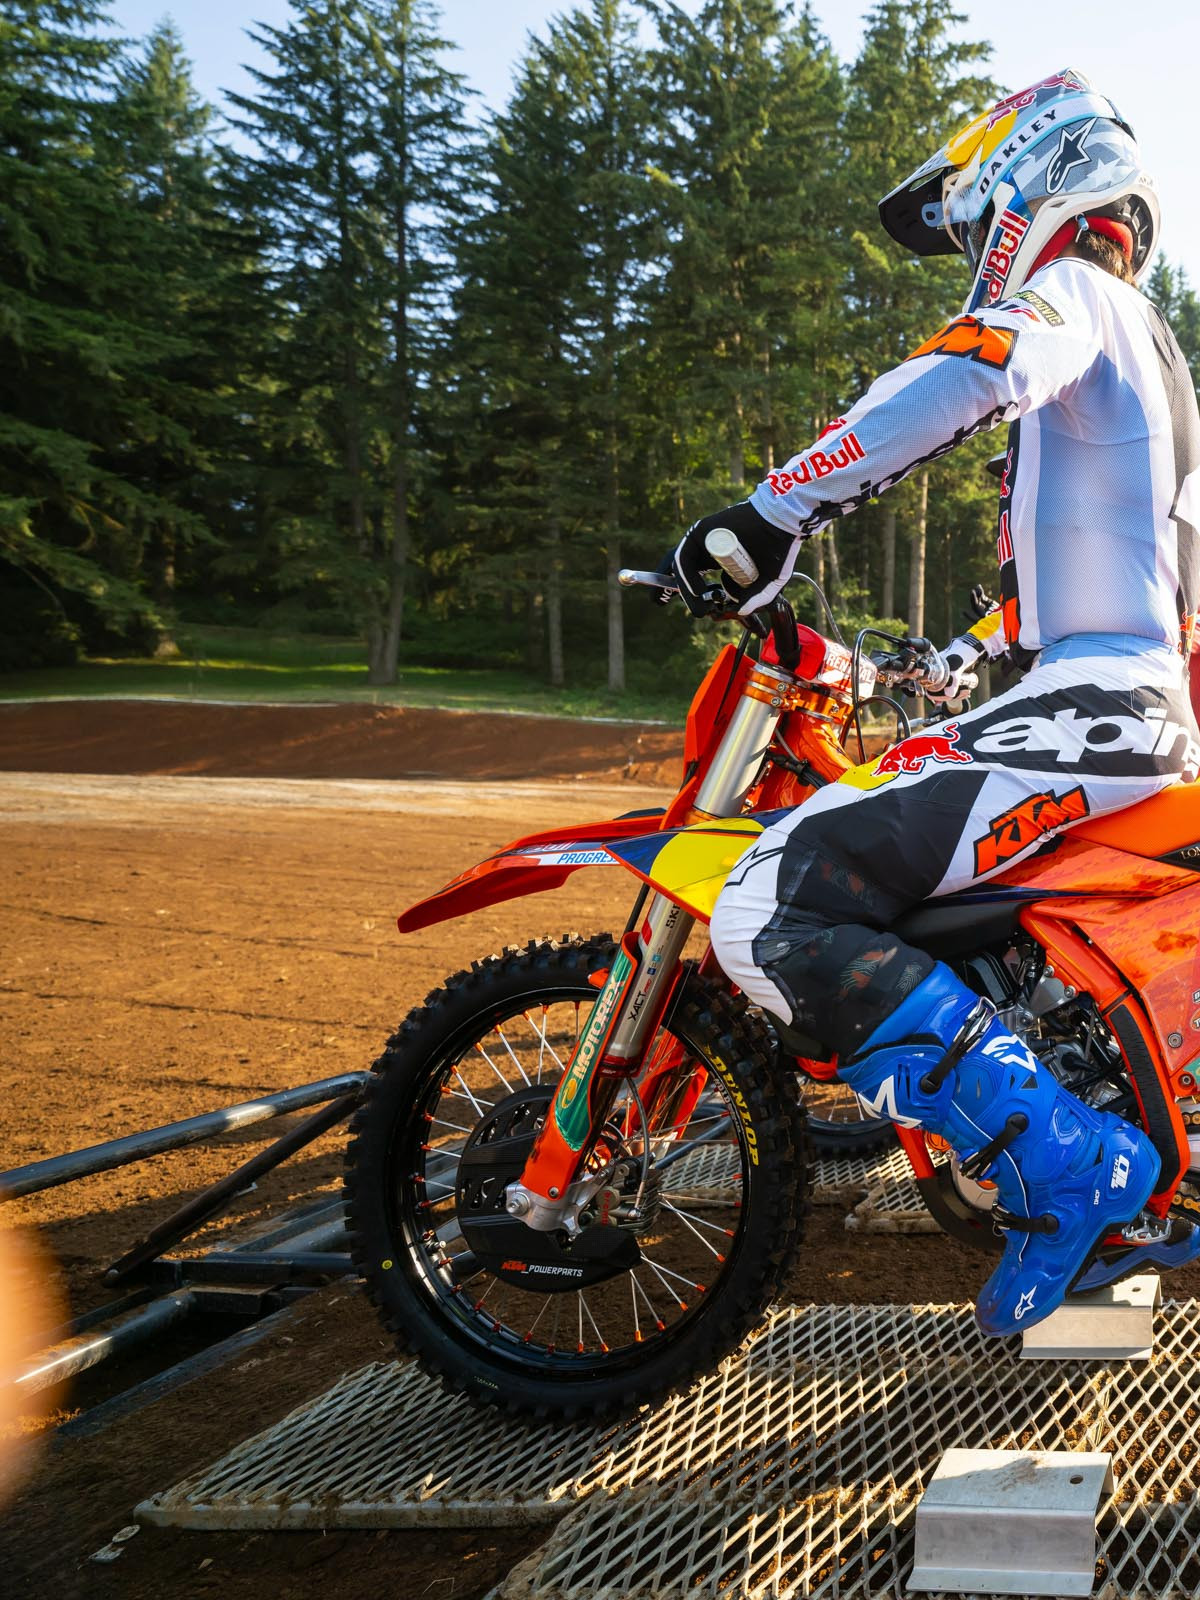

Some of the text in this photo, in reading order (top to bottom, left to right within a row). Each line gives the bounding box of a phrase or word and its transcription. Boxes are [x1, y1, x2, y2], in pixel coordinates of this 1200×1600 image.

[979, 109, 1058, 195] OAKLEY
[985, 209, 1029, 278] Bull
[768, 431, 866, 496] Red Bull
[973, 784, 1091, 879] KTM
[573, 975, 625, 1080] MOTOREX
[628, 990, 648, 1021] XACT
[710, 1055, 759, 1166] DUNLOP
